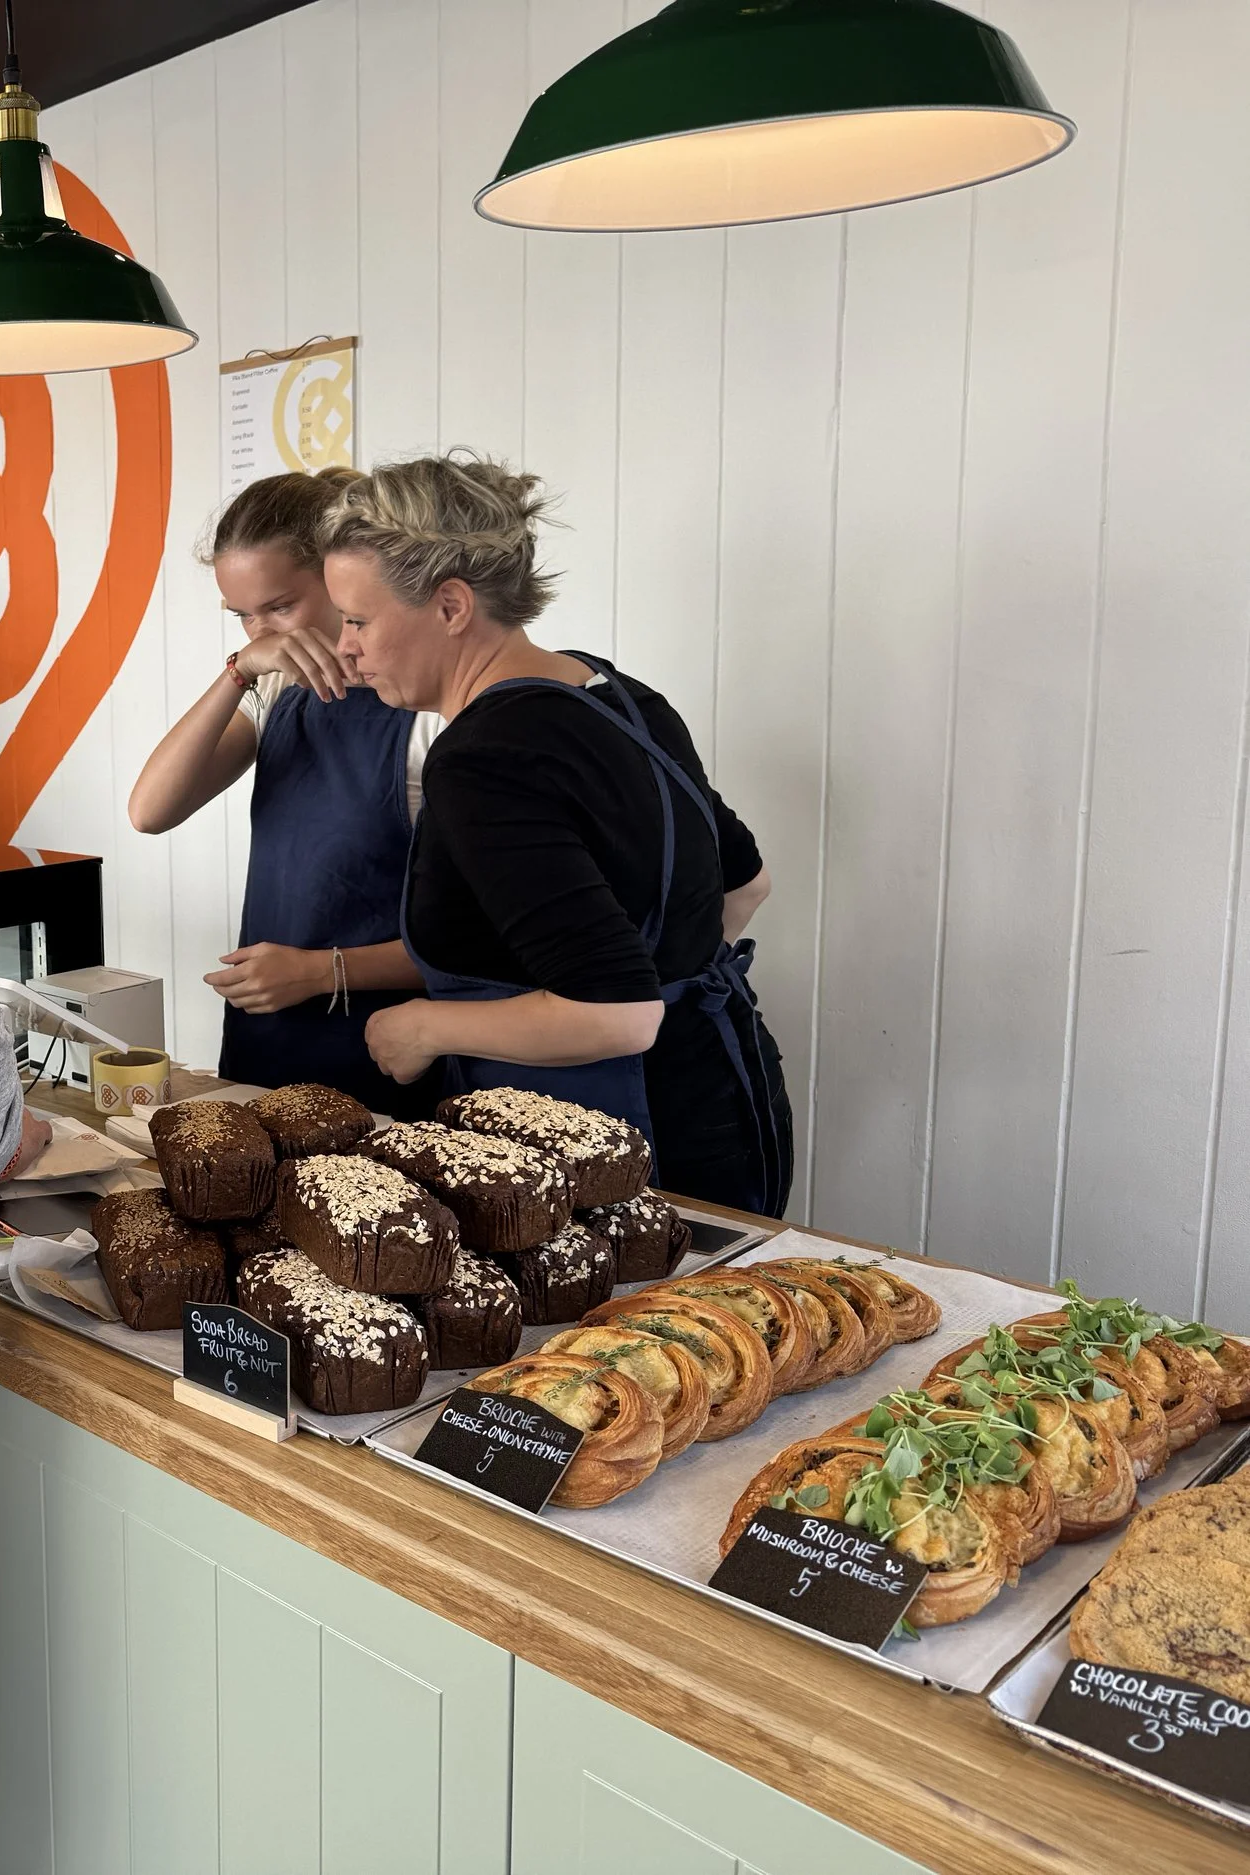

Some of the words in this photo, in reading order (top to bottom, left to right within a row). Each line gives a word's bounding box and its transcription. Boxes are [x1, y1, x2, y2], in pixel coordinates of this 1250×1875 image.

[190, 1310, 227, 1340] SODA
[226, 1318, 269, 1353] BREAD
[223, 1369, 239, 1395] 6
[250, 1354, 282, 1378] NUT
[478, 1397, 542, 1433] BRIOCHE
[540, 1427, 567, 1444] WITH
[475, 1445, 504, 1474] 5
[799, 1518, 886, 1564] BRIOCHE
[788, 1566, 822, 1597] 5
[839, 1560, 909, 1596] CHEESE
[1072, 1662, 1206, 1714] CHOCOLATE
[1208, 1698, 1250, 1729] COO
[1099, 1687, 1172, 1722] VANILLA
[1176, 1710, 1229, 1737] SALT
